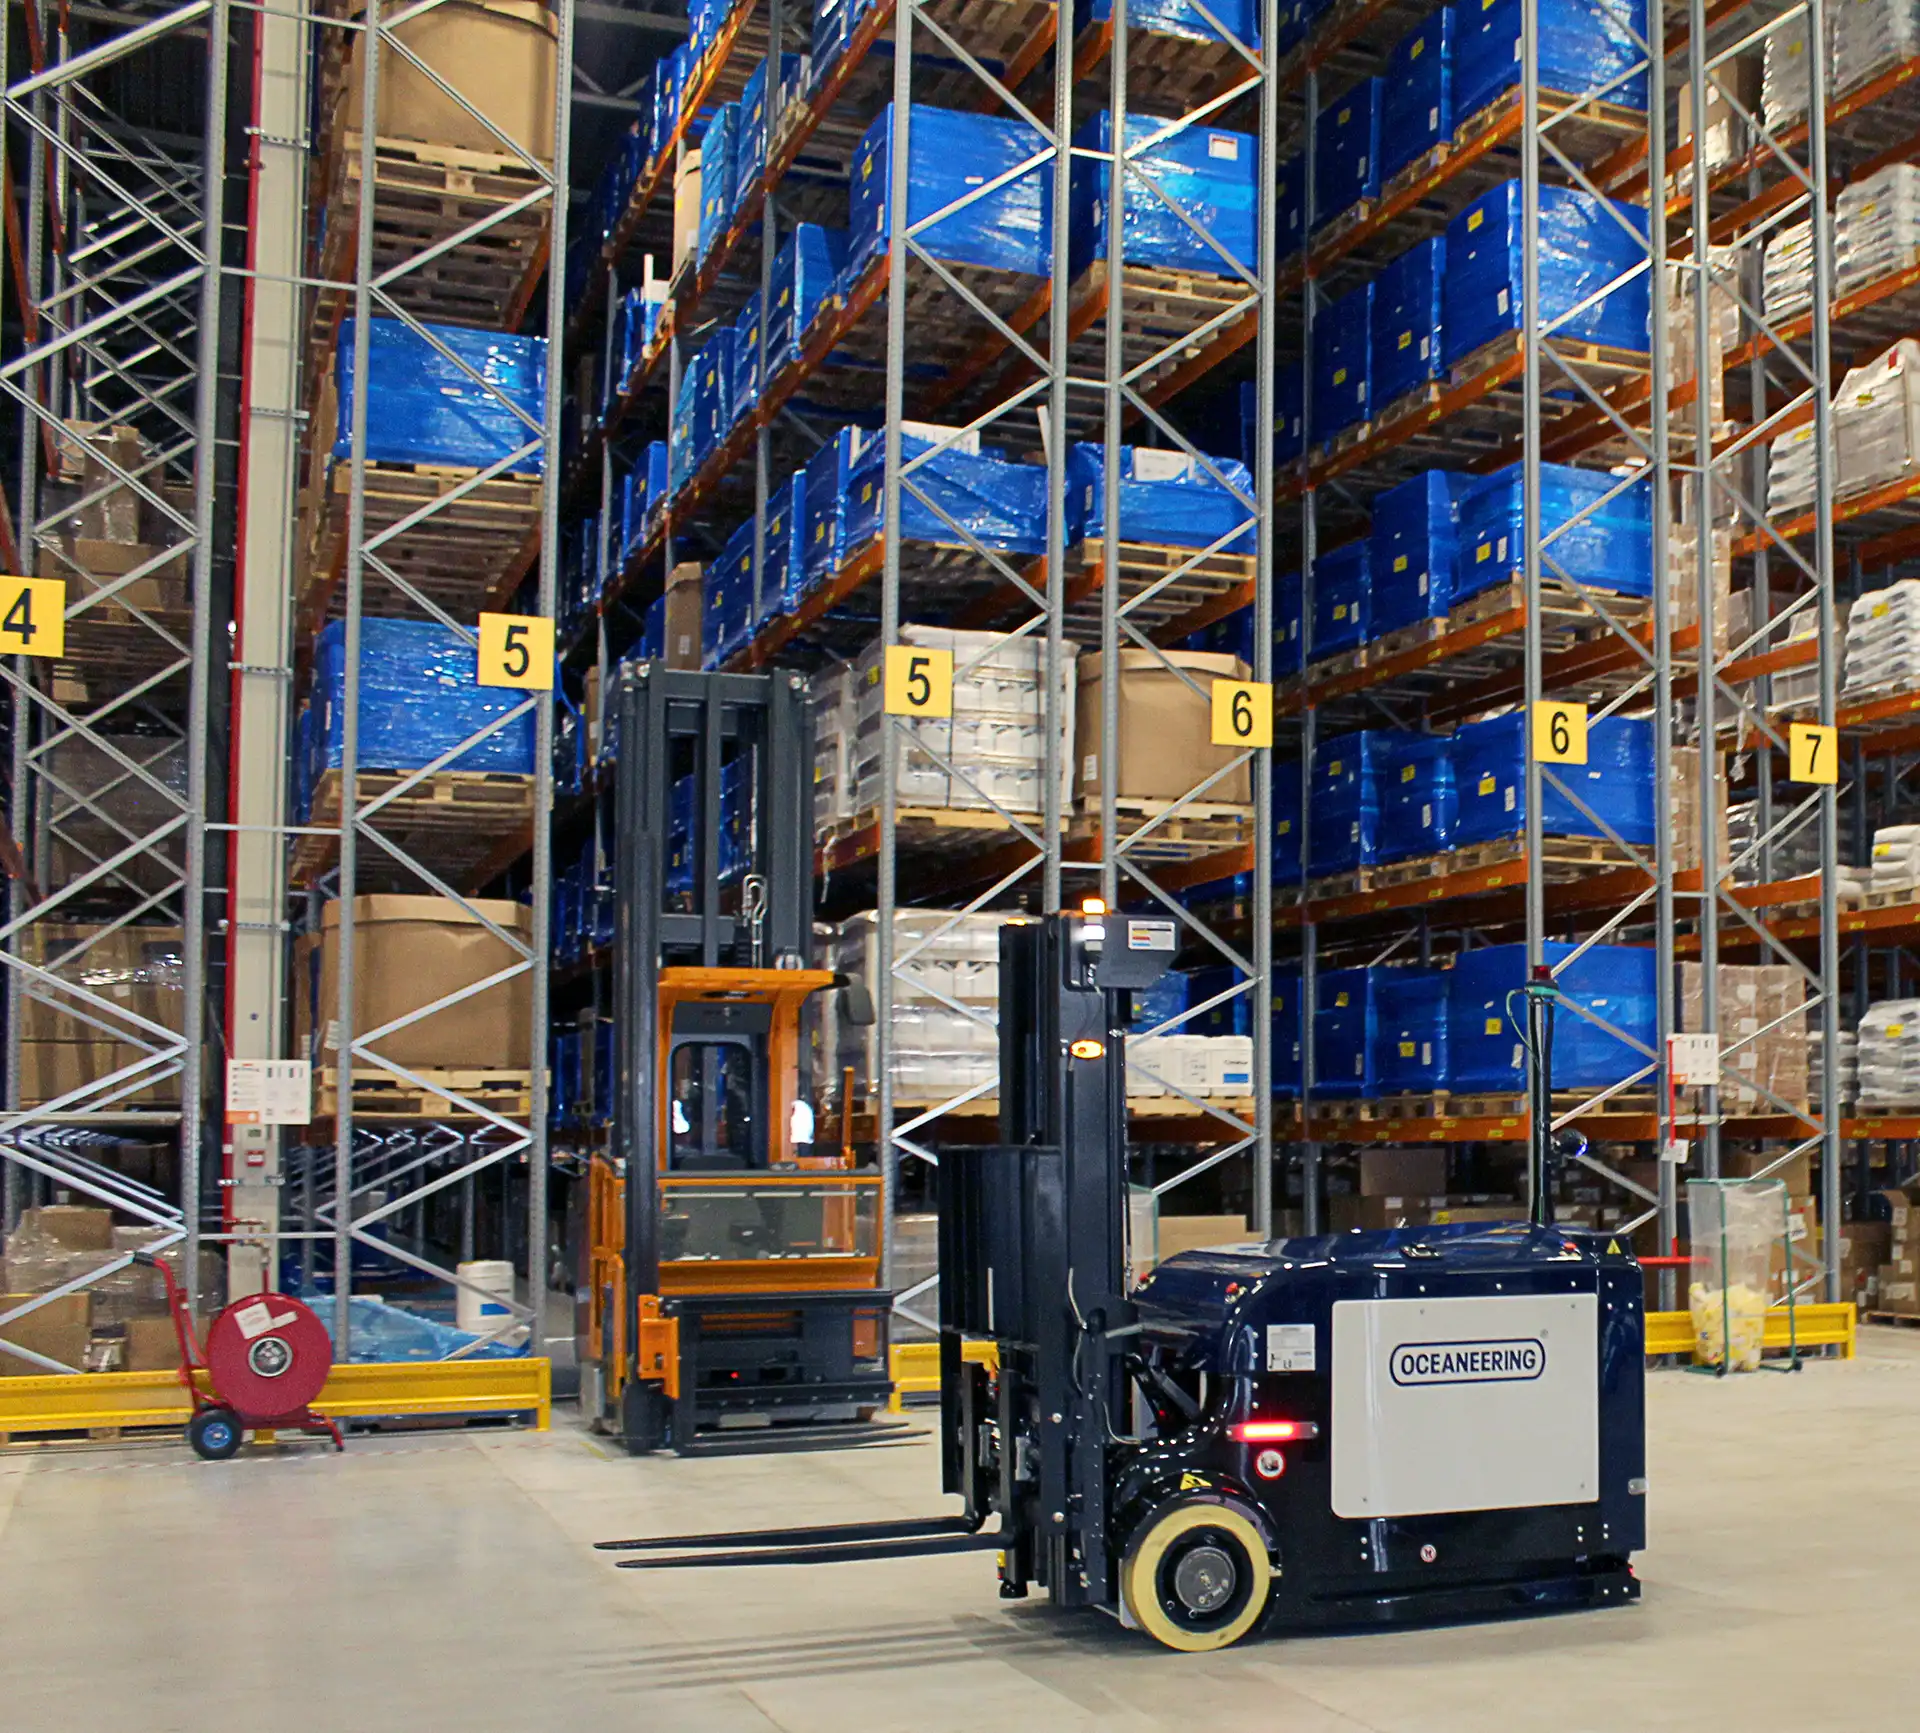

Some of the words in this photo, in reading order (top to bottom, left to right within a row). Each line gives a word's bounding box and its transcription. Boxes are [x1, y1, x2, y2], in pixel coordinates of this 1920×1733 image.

[2, 588, 37, 645] 4
[503, 625, 530, 678] 5
[907, 657, 931, 706] 5
[1231, 690, 1253, 737] 6
[1551, 711, 1570, 755] 6
[1805, 734, 1822, 774] 7
[1400, 1349, 1536, 1376] OCEANEERING
